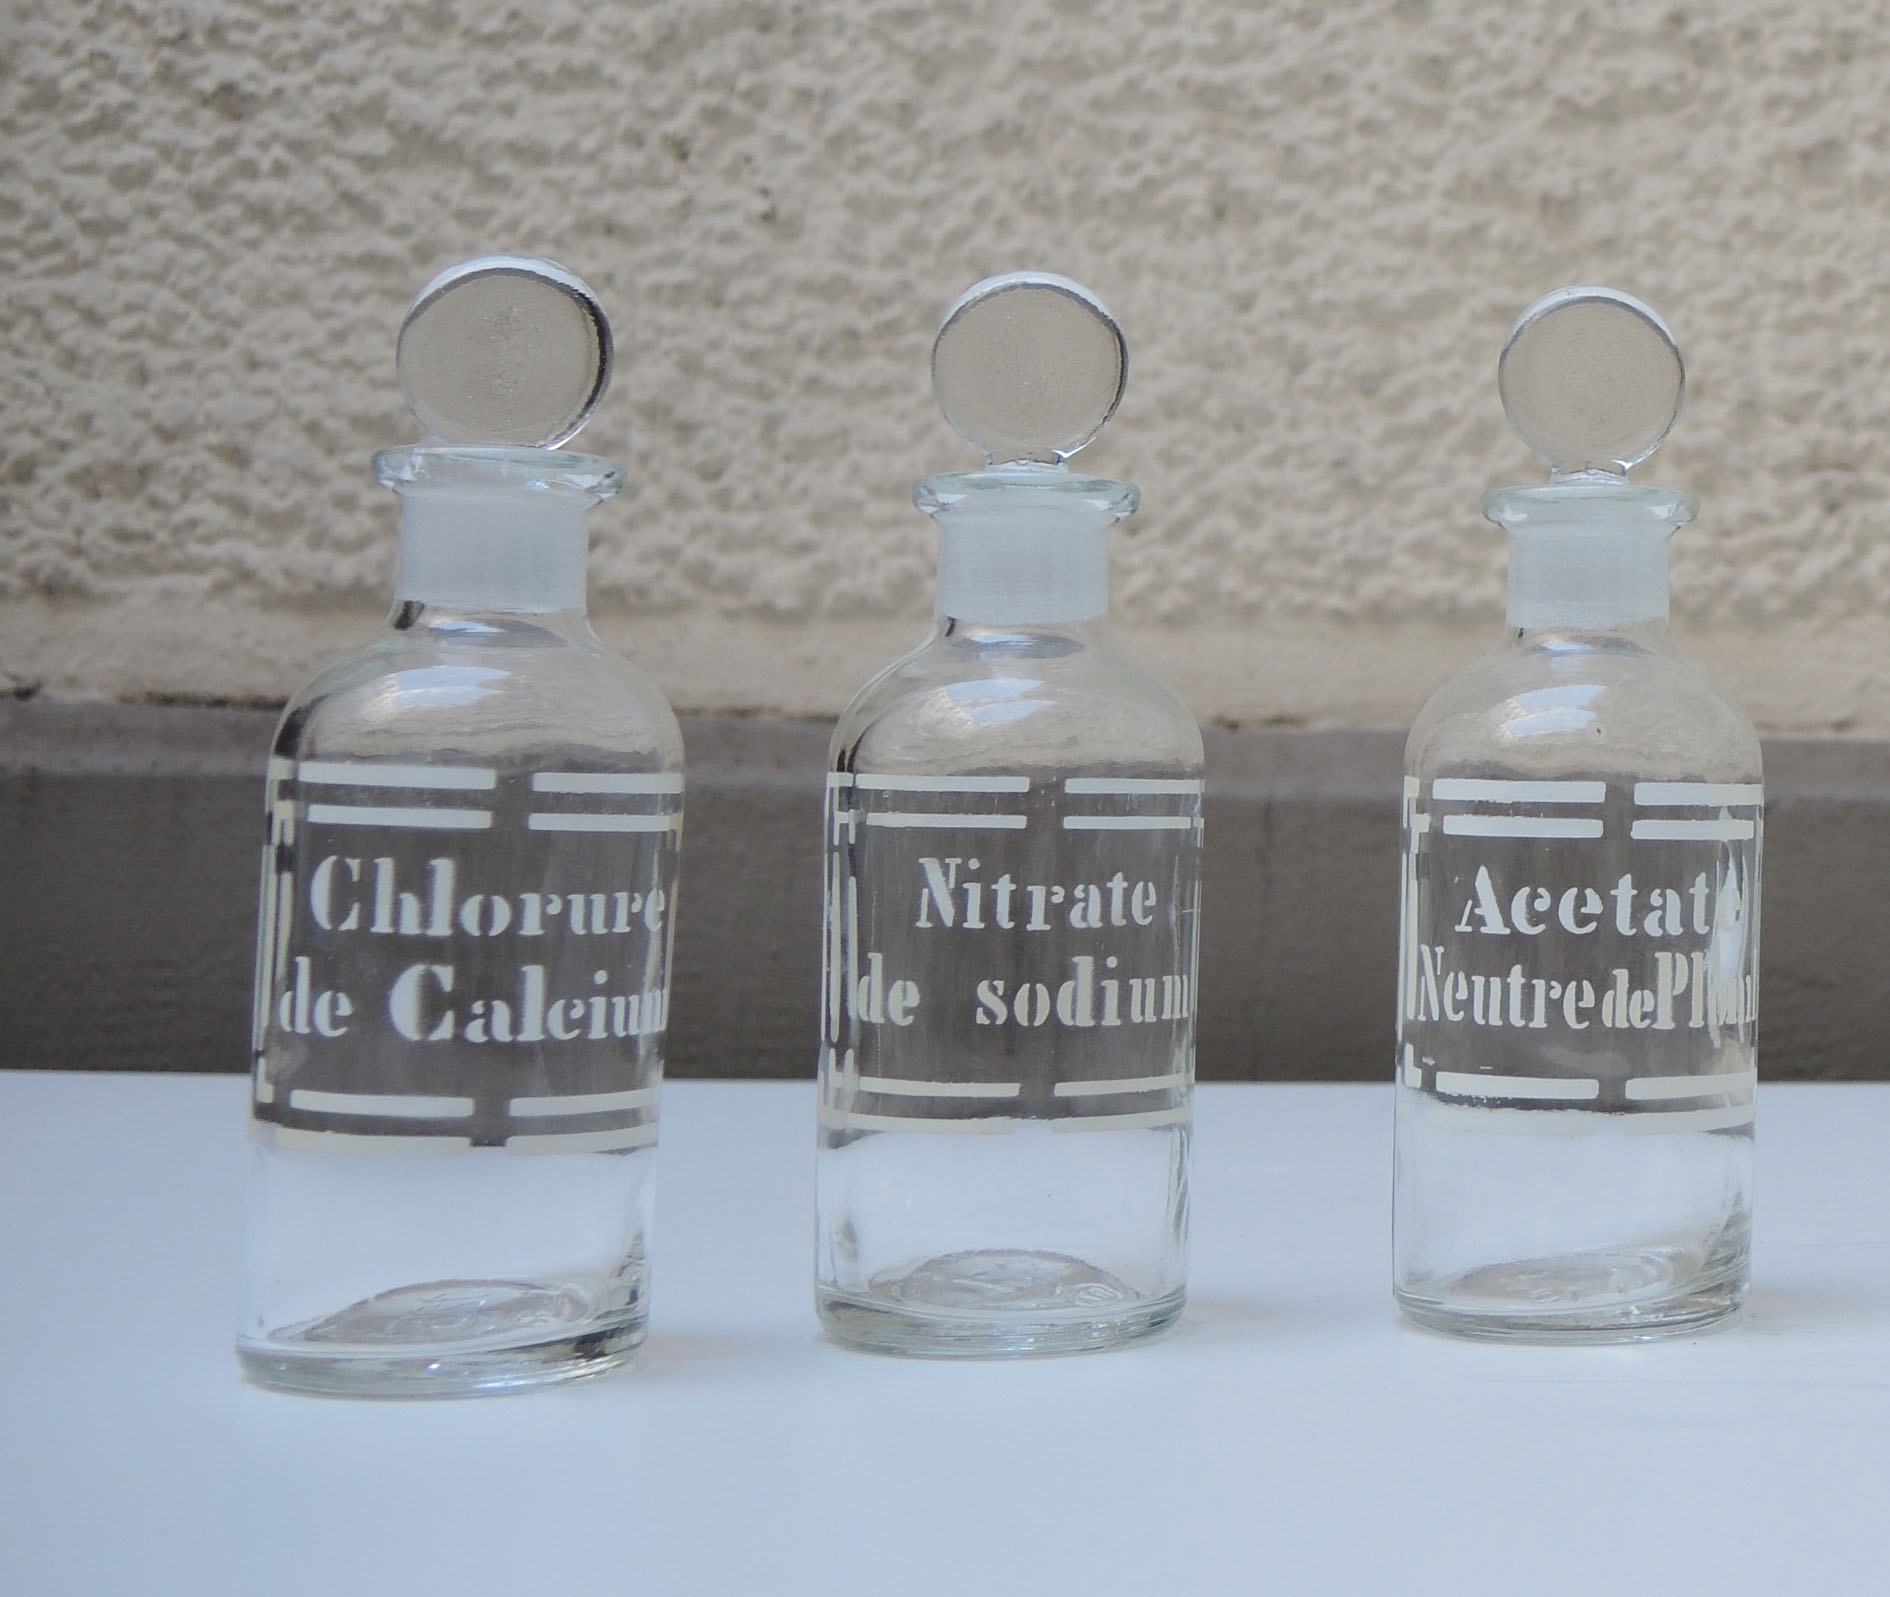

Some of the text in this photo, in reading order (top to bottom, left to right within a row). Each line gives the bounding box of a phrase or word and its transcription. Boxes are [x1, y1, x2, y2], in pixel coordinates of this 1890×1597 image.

[310, 855, 666, 936] Chlorure
[914, 857, 1157, 931] Nitrate
[278, 956, 354, 1037] de
[857, 952, 1189, 1027] de sodium
[1417, 943, 1596, 1030] Neutre
